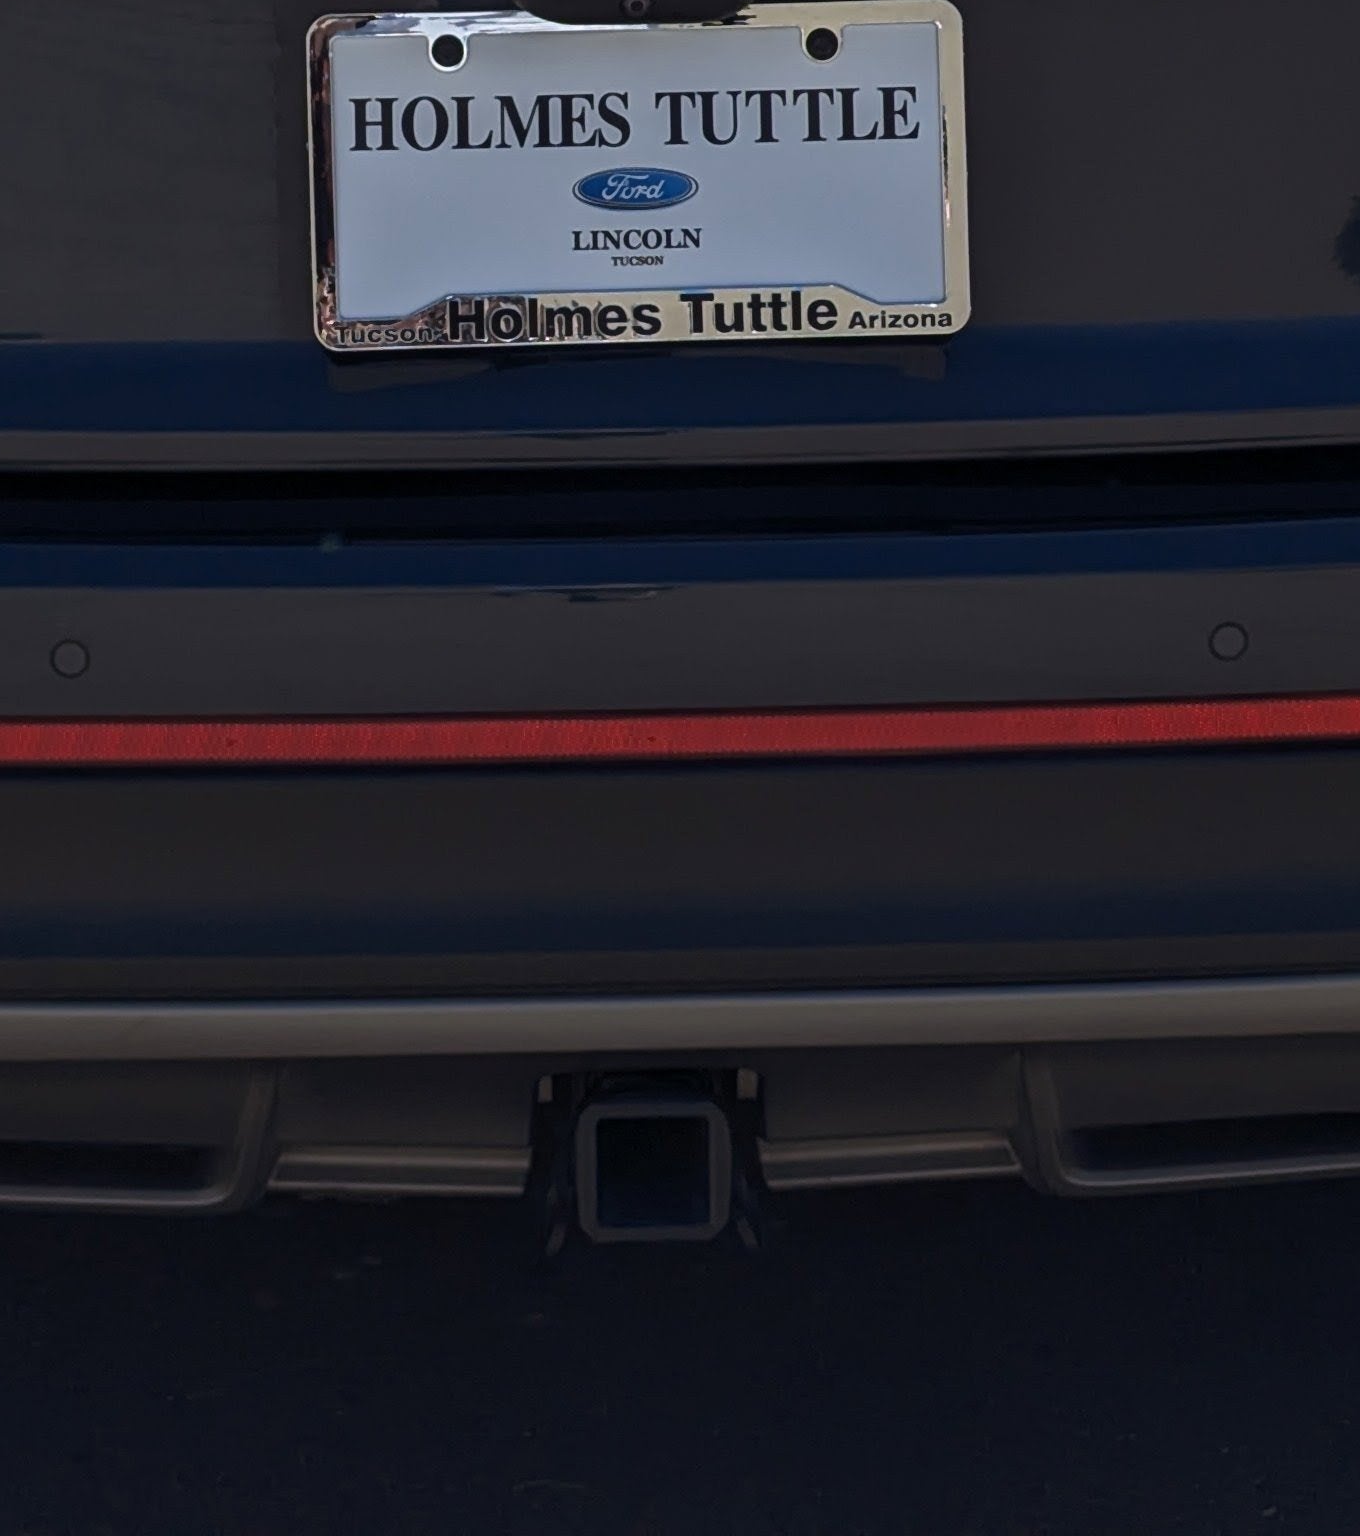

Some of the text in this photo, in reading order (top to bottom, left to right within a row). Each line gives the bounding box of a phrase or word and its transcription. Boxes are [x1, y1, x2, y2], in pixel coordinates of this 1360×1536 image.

[349, 86, 921, 151] HOLMES TUTTLE
[572, 228, 702, 250] LINCOLN
[611, 255, 664, 266] TUCSON
[338, 290, 952, 344] Tucson Holmes Tuttle Arizona
